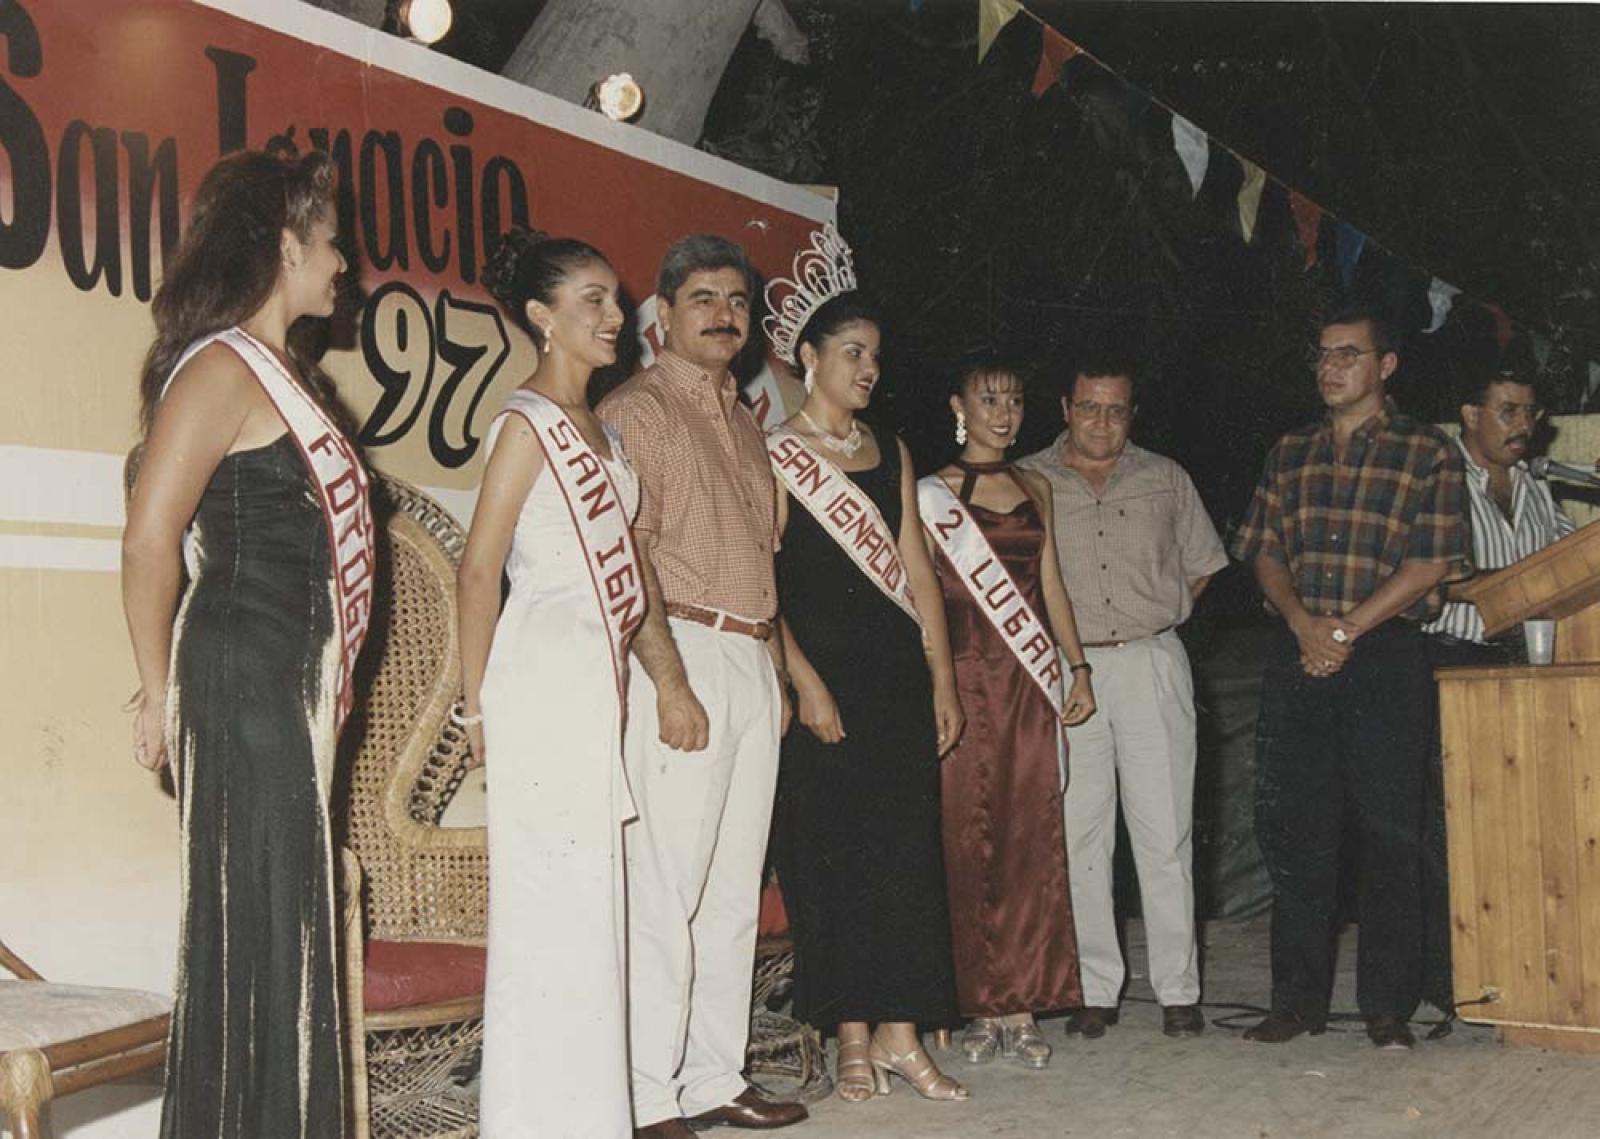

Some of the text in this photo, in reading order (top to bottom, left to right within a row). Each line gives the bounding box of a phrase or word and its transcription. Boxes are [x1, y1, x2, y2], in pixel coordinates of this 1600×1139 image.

[0, 0, 530, 302] San Inacio
[358, 282, 510, 469] 97
[548, 419, 642, 648] SAN IGN
[769, 438, 902, 592] SAN IGNACIO
[935, 509, 1061, 689] 2 LUGAR
